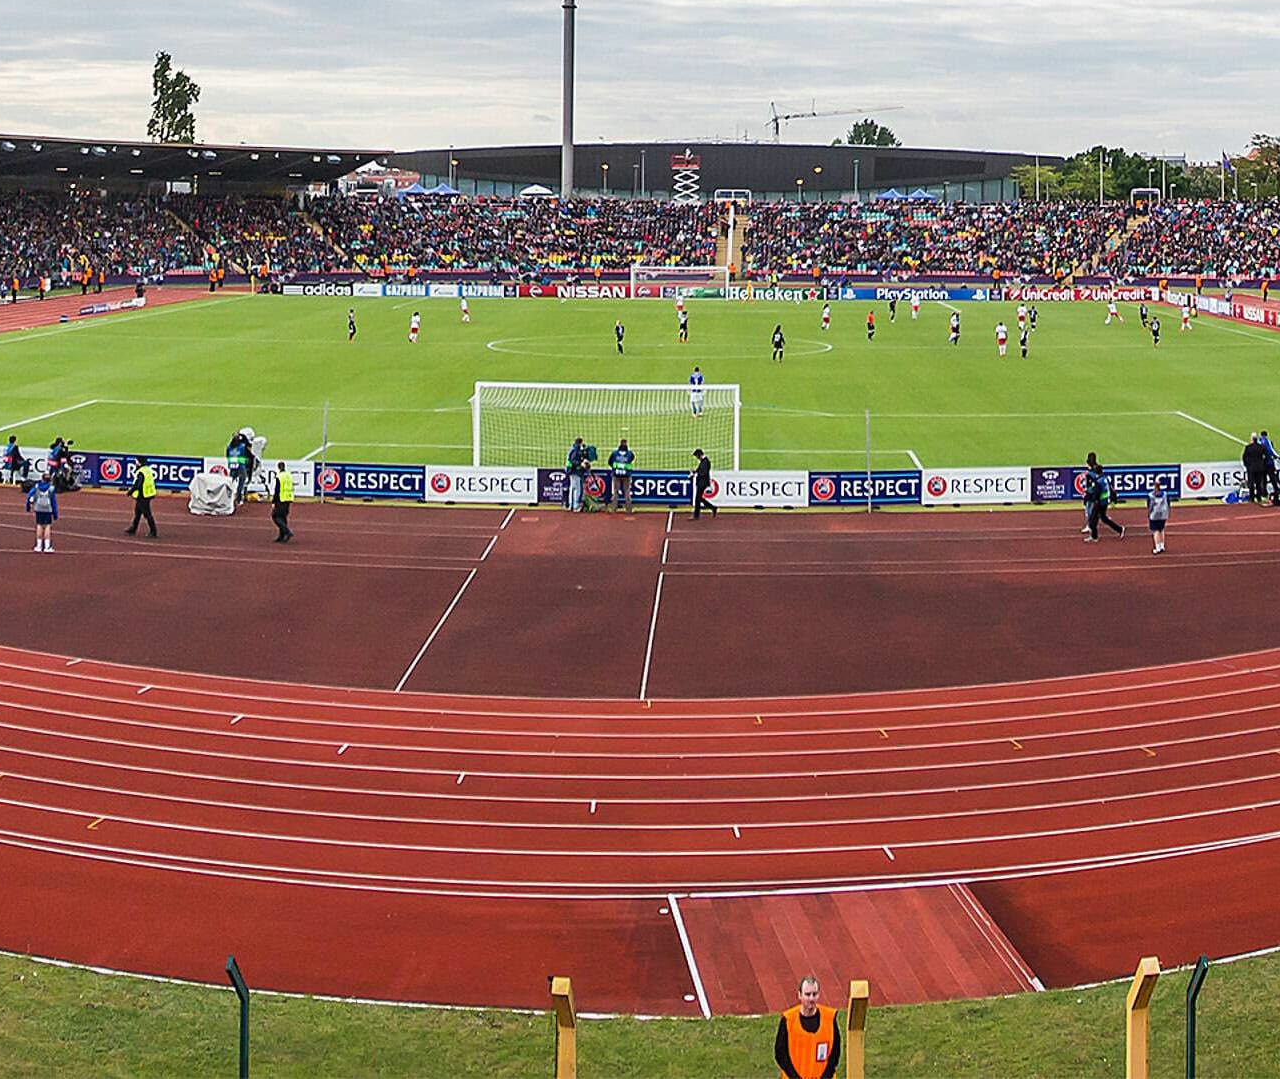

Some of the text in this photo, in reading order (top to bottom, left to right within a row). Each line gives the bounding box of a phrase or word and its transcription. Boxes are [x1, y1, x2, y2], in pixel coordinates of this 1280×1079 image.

[304, 283, 352, 297] adidas
[557, 285, 626, 298] NISSAN
[876, 288, 949, 301] PlayStation
[1022, 287, 1075, 301] UniCredit
[1092, 287, 1145, 301] UniCredit
[126, 463, 202, 482] RSPECT
[345, 472, 423, 491] RESPECT
[455, 477, 534, 493] RESPECT
[726, 481, 804, 496] RESPECT
[840, 479, 919, 497] RESPECT
[951, 477, 1027, 494] RESPECT
